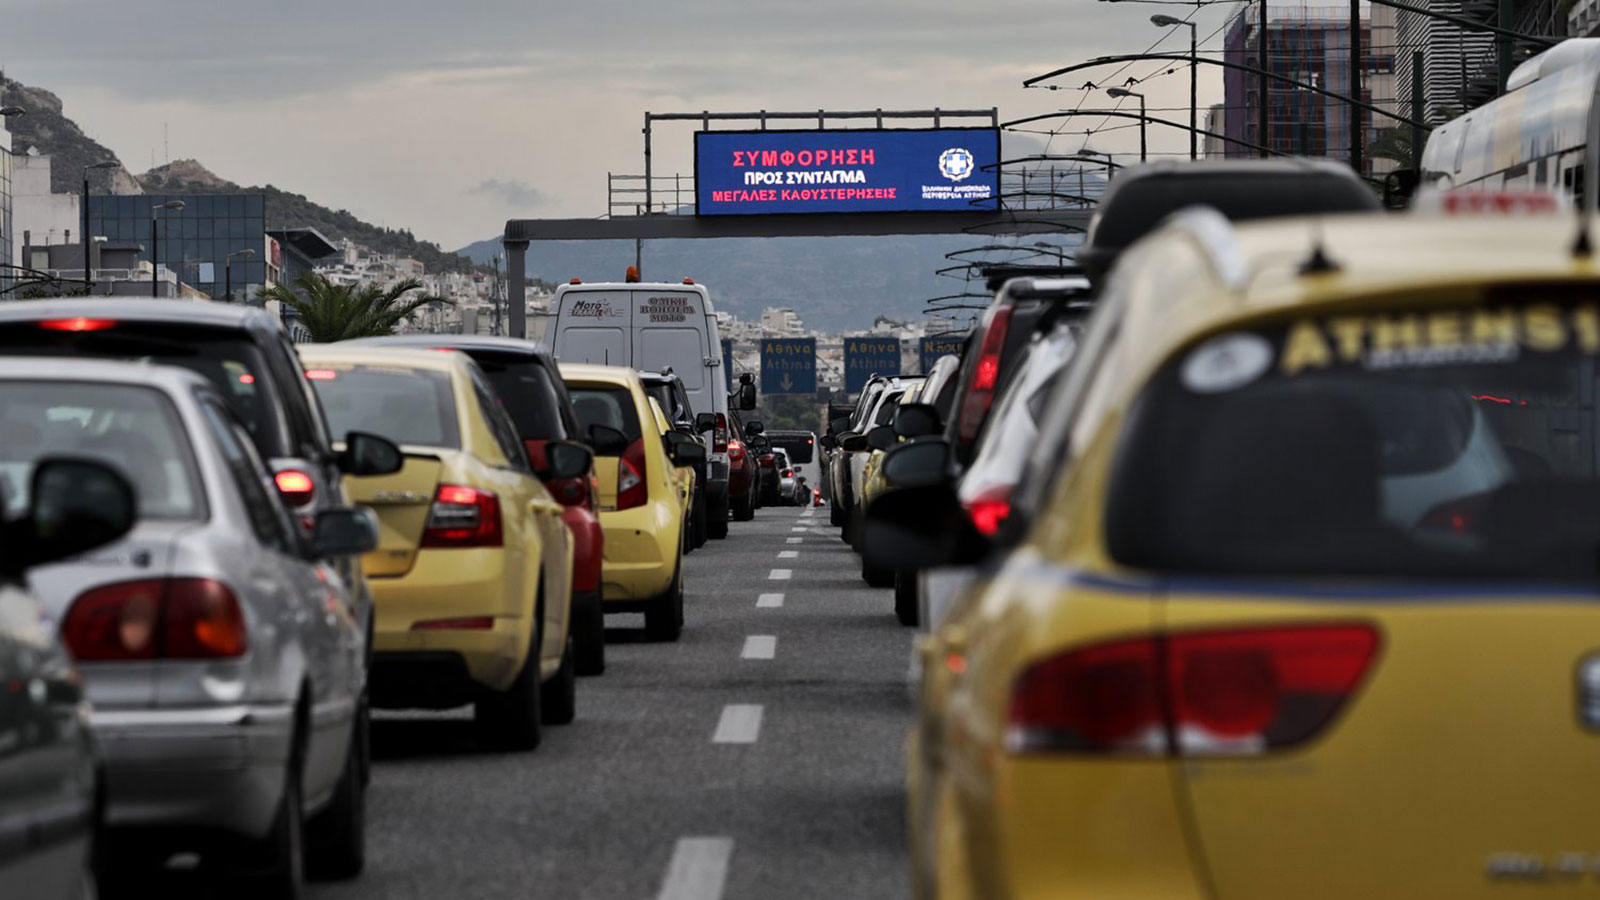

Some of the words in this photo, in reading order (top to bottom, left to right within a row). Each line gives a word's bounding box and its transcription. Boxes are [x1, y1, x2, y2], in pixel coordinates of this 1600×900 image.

[733, 149, 876, 167] ΣΥΜΦΟΡΗΣΗ
[744, 171, 783, 185] ΠΡΟΣ
[786, 170, 866, 185] ΣΥΝΤΑΓΜΑ
[712, 189, 777, 202] ΜΕΓΑΛΕΣ
[781, 187, 896, 201] ΚΑΘΥΣΤΕΡΗΣΕΙΣ
[767, 359, 811, 370] Athina
